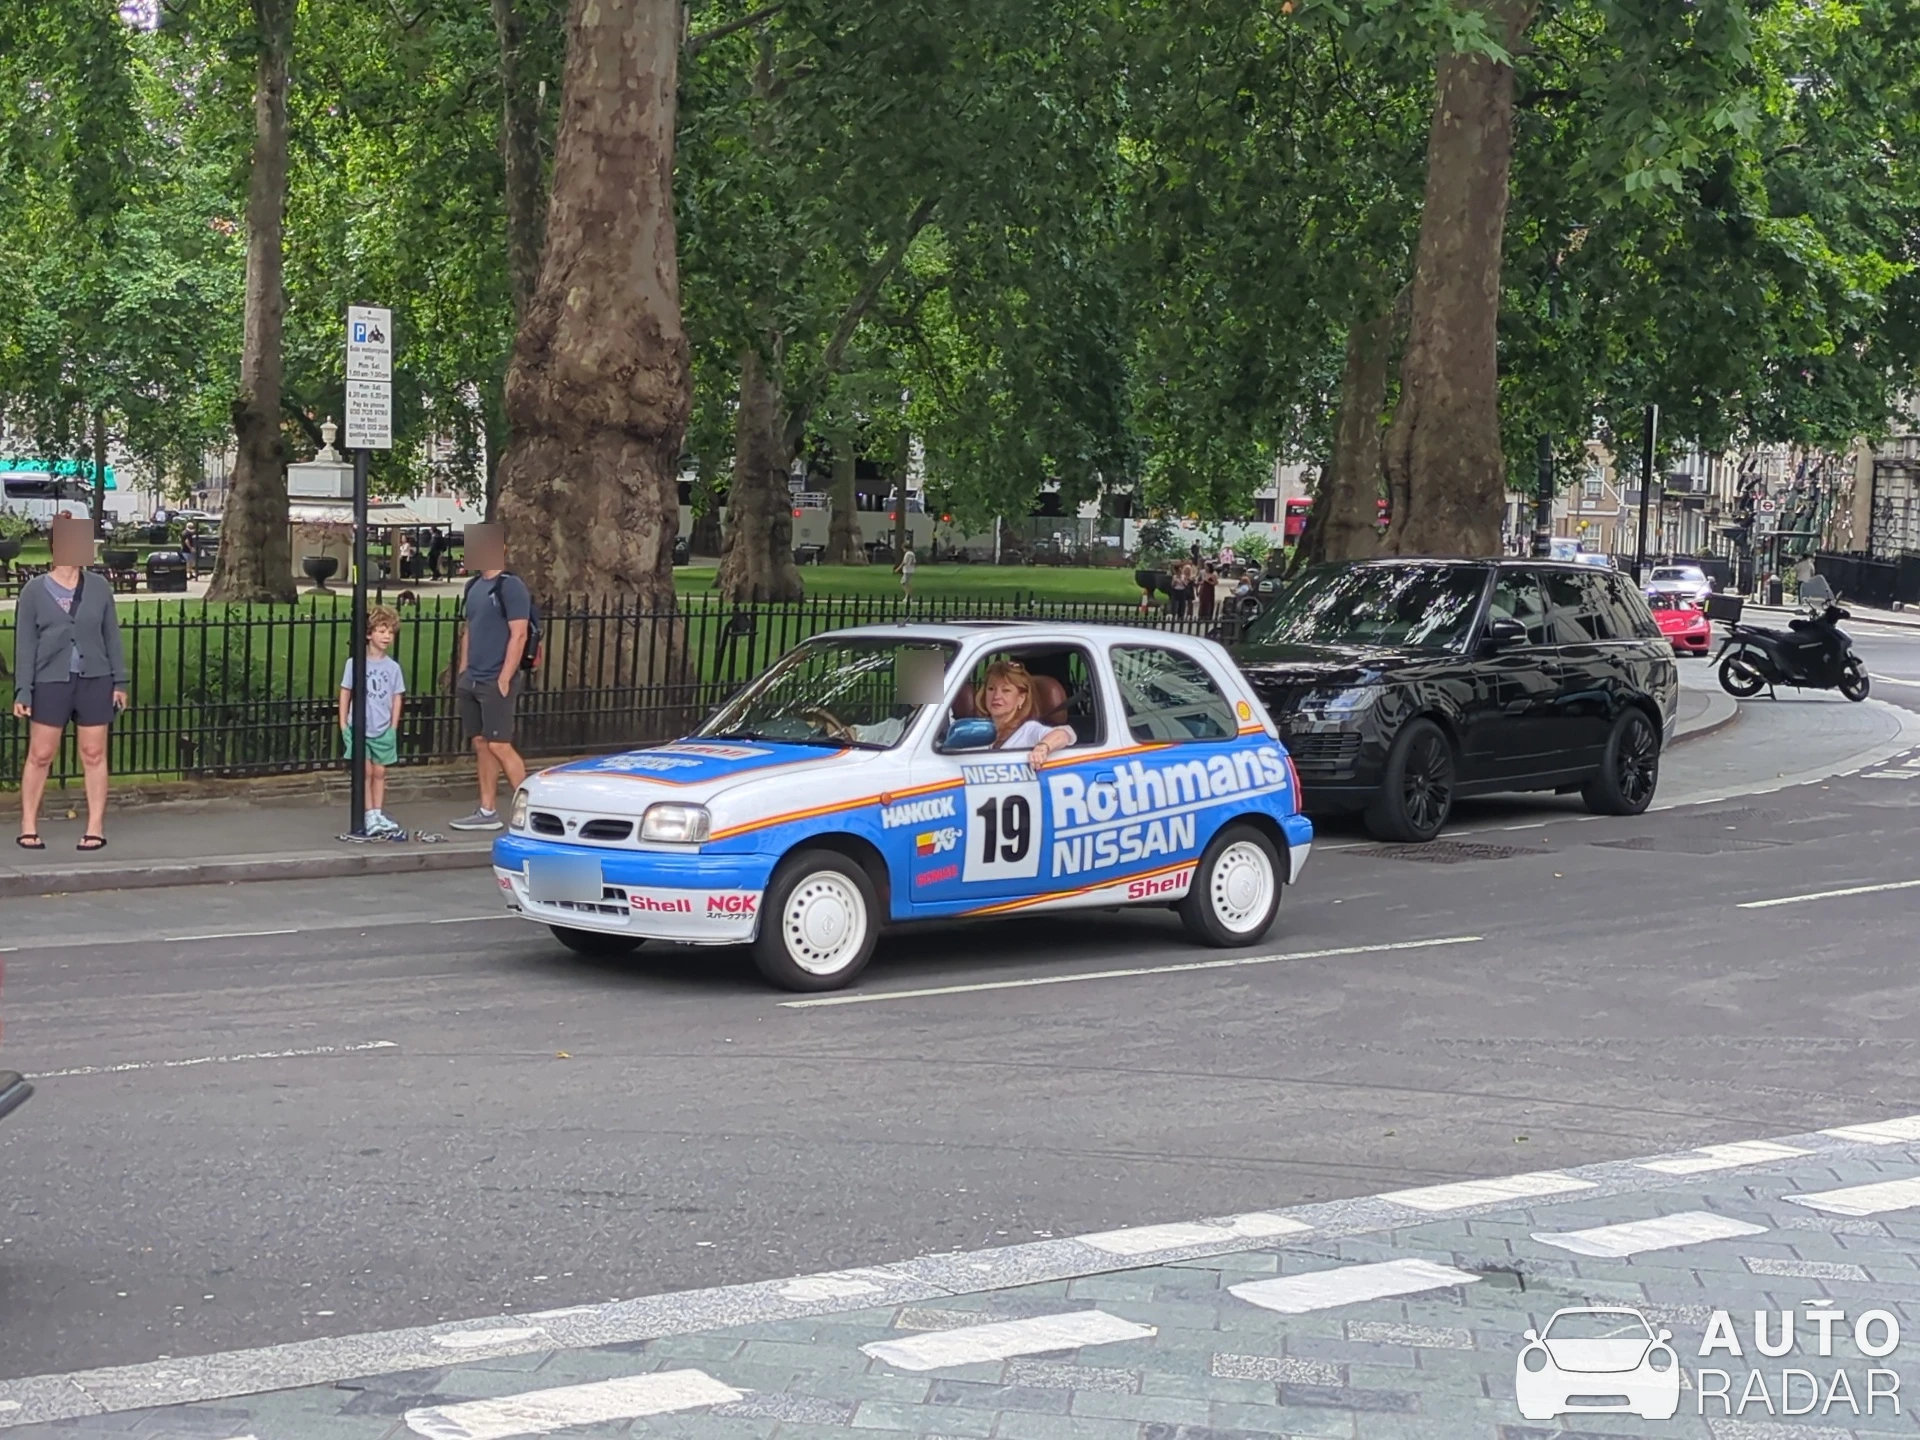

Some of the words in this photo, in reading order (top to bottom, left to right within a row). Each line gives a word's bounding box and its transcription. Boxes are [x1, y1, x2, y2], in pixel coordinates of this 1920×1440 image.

[356, 324, 365, 341] P
[963, 764, 1037, 785] NISSAN
[1048, 746, 1286, 829] Rothmans
[881, 796, 956, 829] HANKOOK
[976, 794, 1031, 864] 19
[1052, 813, 1195, 878] NISSAN
[1128, 872, 1189, 900] Shell
[630, 895, 692, 913] Shell
[706, 894, 757, 913] NGK
